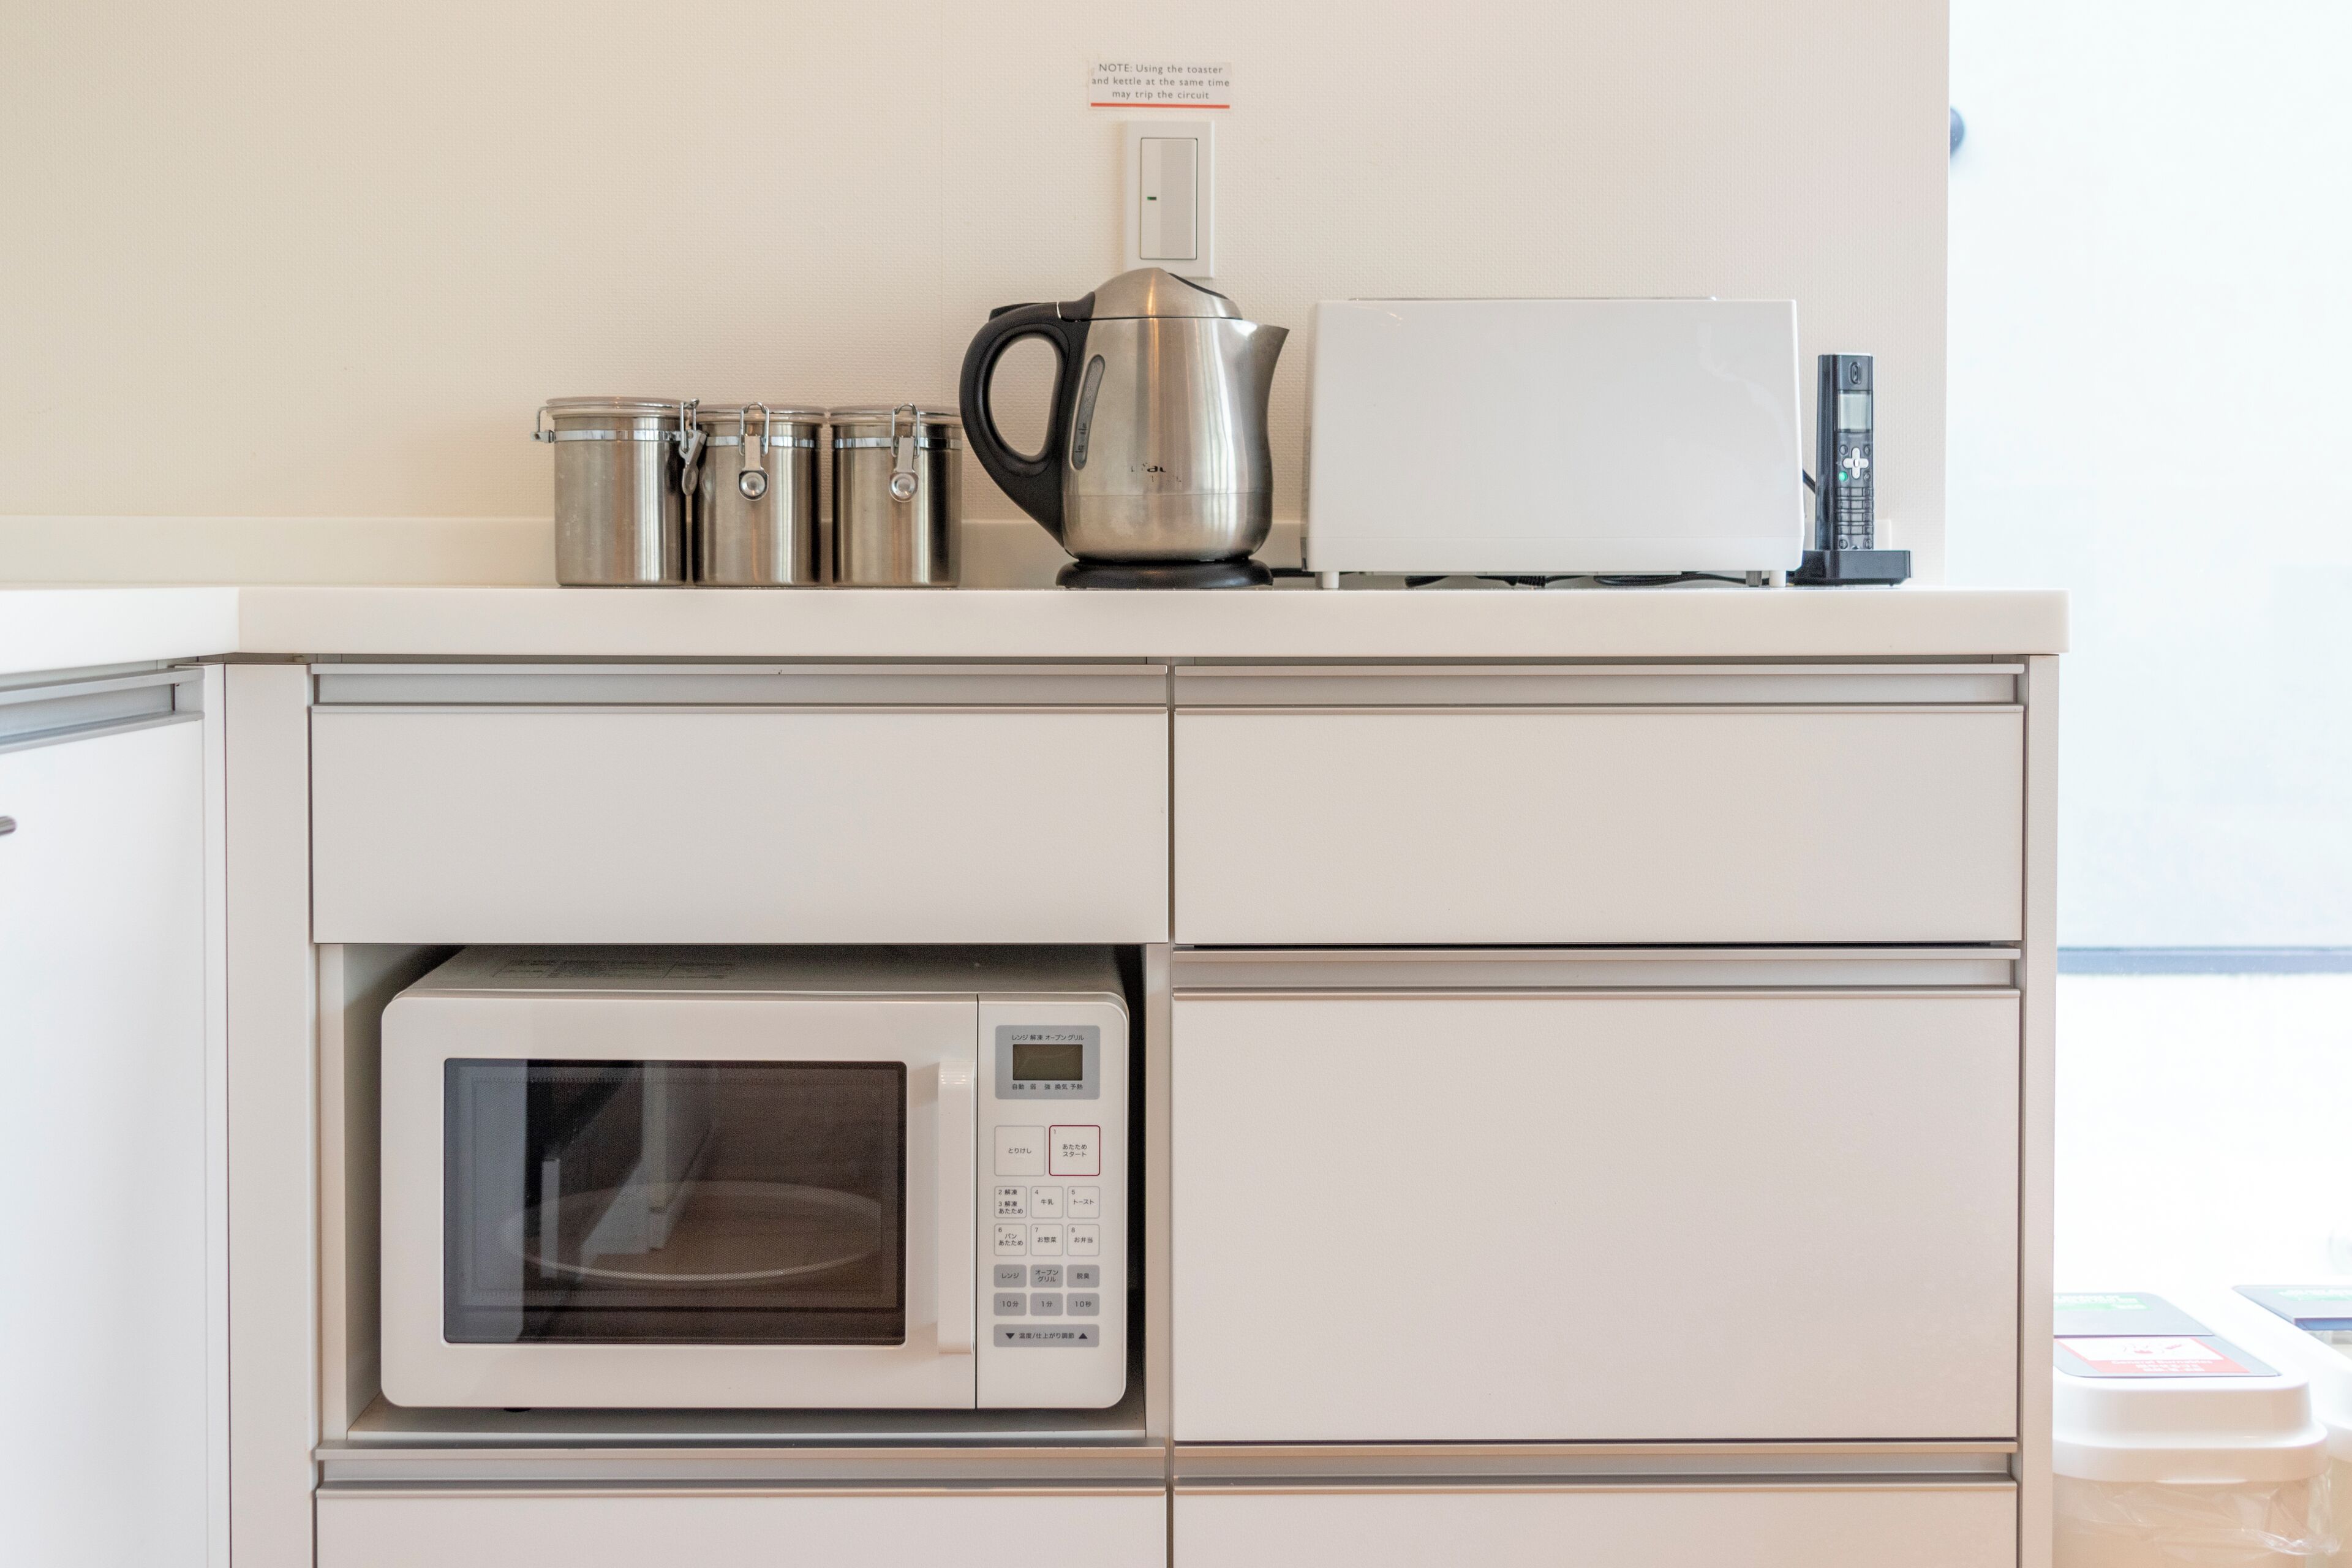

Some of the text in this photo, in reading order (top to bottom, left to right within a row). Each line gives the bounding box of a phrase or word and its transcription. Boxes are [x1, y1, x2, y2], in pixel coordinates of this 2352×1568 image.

[1099, 62, 1223, 75] NOTE: Using the toaster
[1113, 76, 1142, 85] kettle
[1208, 78, 1230, 87] time
[1112, 90, 1209, 100] may trip the circuit
